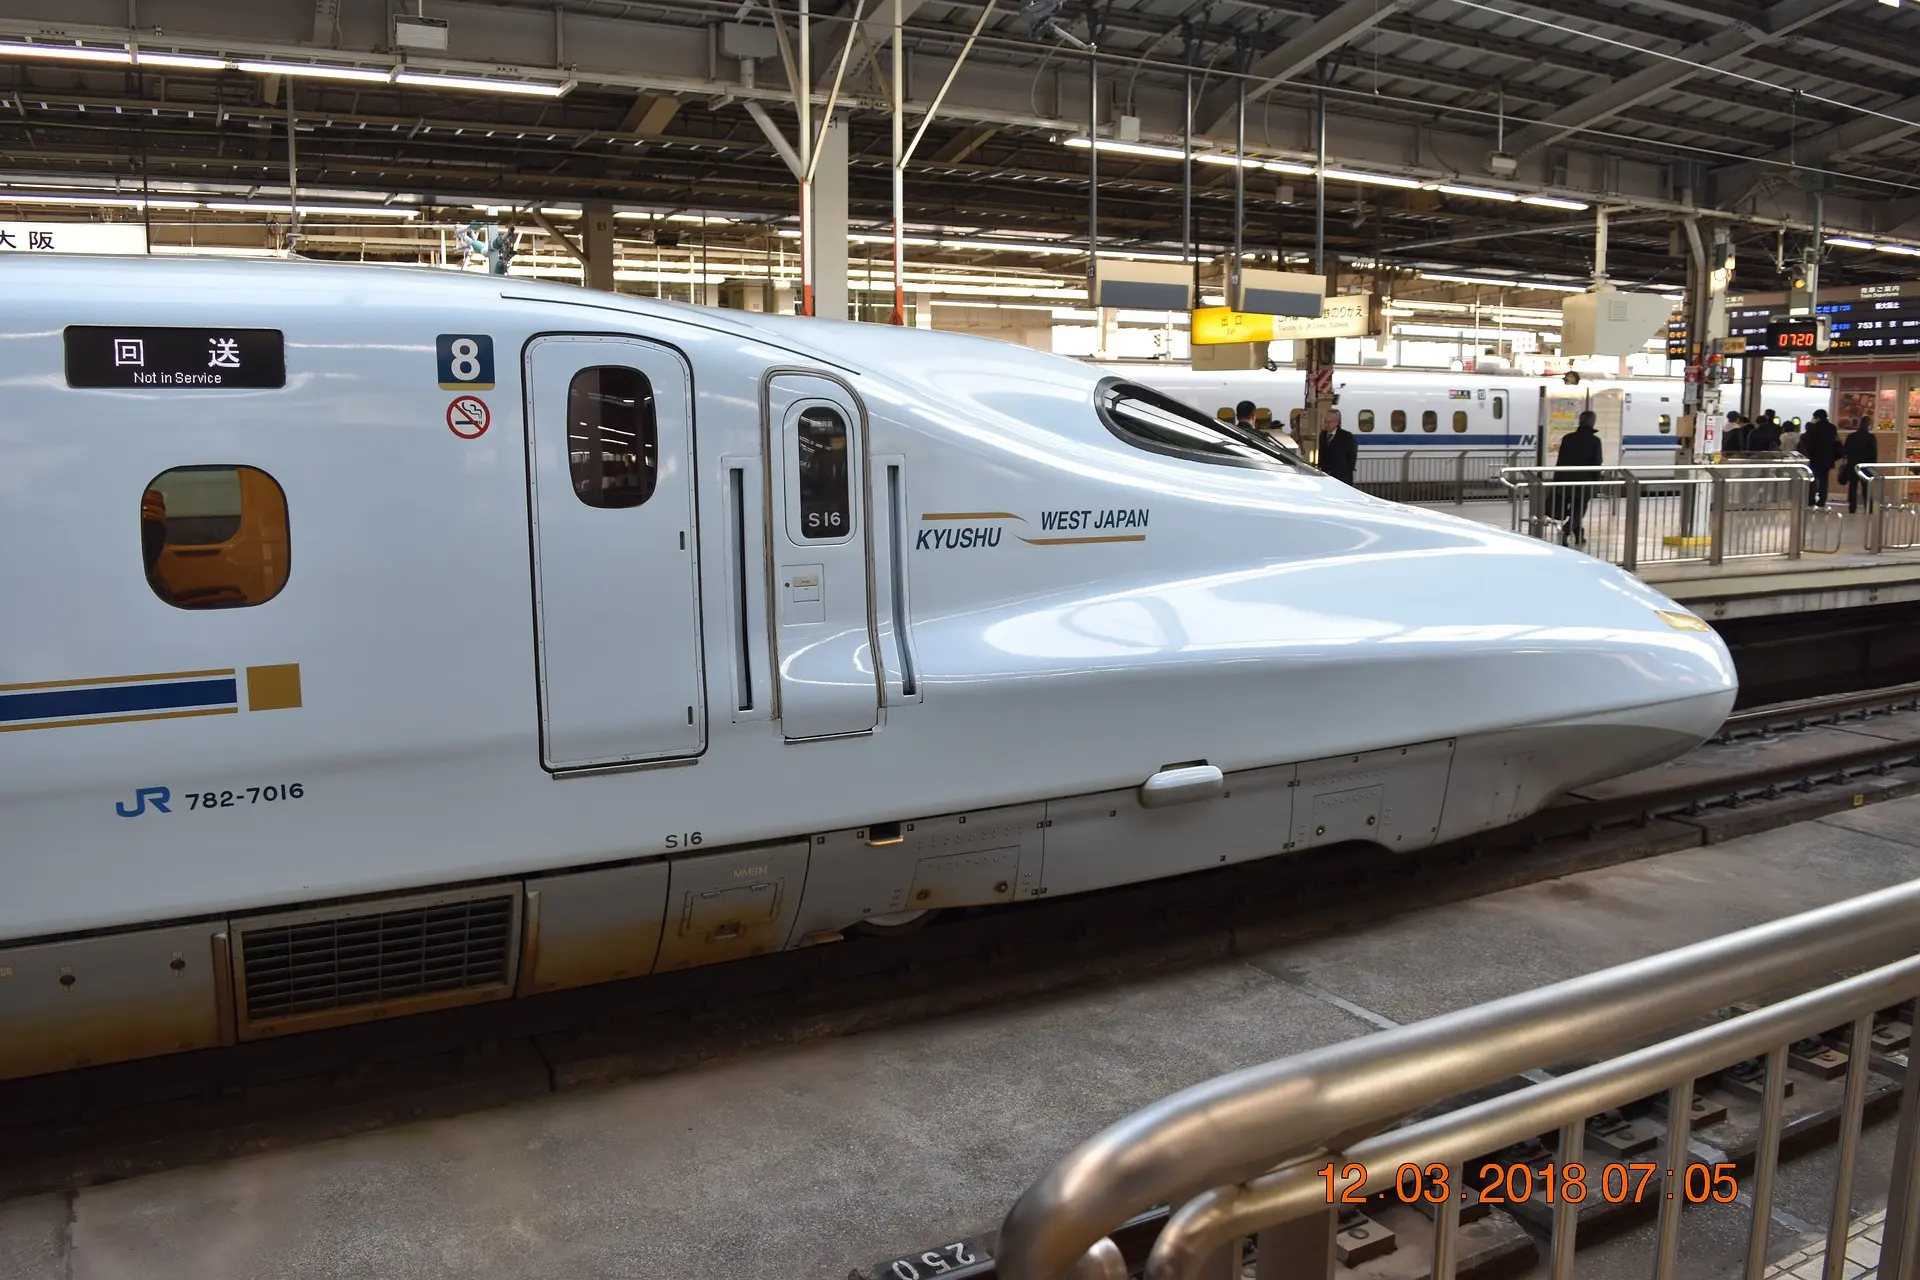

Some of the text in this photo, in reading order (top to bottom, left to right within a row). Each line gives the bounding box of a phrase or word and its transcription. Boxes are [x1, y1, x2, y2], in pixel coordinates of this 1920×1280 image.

[0, 229, 55, 250] 大阪
[1778, 333, 1815, 347] 0720
[113, 337, 241, 368] 回送
[451, 338, 481, 381] 8
[133, 371, 222, 384] Not in Service
[808, 511, 841, 527] S16
[1041, 508, 1150, 531] WEST JAPAN
[915, 526, 1002, 550] KYUSHU
[115, 782, 305, 818] JR 782-7016
[665, 831, 703, 849] S16
